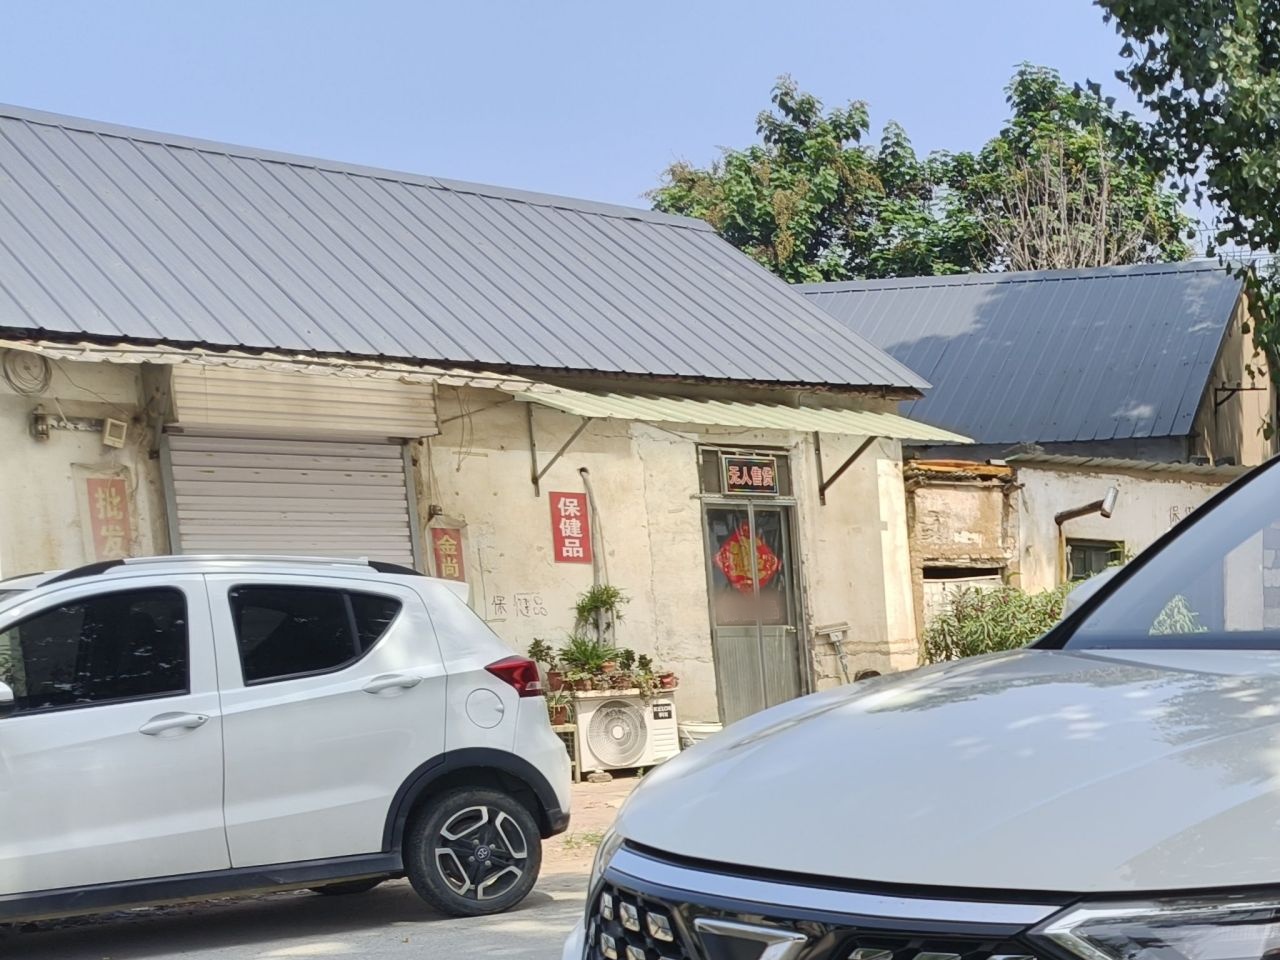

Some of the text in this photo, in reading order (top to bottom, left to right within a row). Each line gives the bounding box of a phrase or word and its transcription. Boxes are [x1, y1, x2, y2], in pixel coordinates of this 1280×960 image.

[728, 465, 774, 487] 无人售货
[95, 486, 127, 556] 批发
[557, 496, 583, 557] 保健品
[437, 534, 460, 577] 金尚
